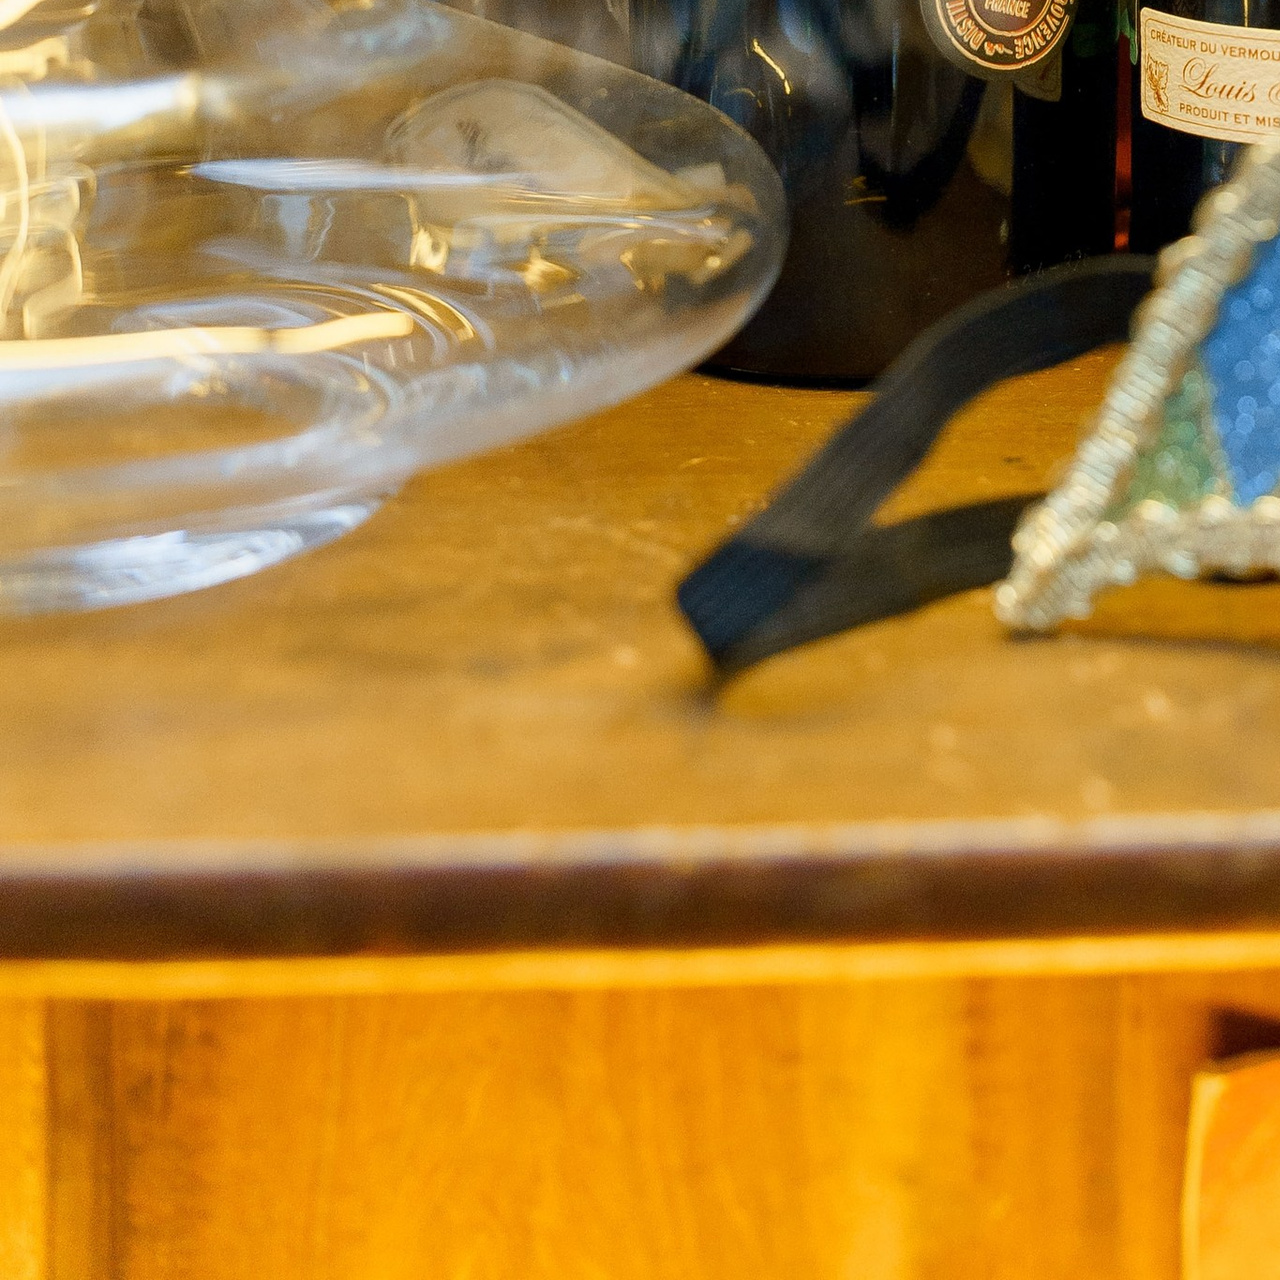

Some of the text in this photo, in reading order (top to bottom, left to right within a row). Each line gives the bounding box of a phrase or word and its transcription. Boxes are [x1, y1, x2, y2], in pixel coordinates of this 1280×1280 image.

[1150, 27, 1197, 51] CRÉATEUR
[1200, 42, 1217, 55] DU
[1178, 57, 1258, 103] Louis
[1179, 103, 1229, 122] PRODUIT
[1234, 113, 1250, 125] ET
